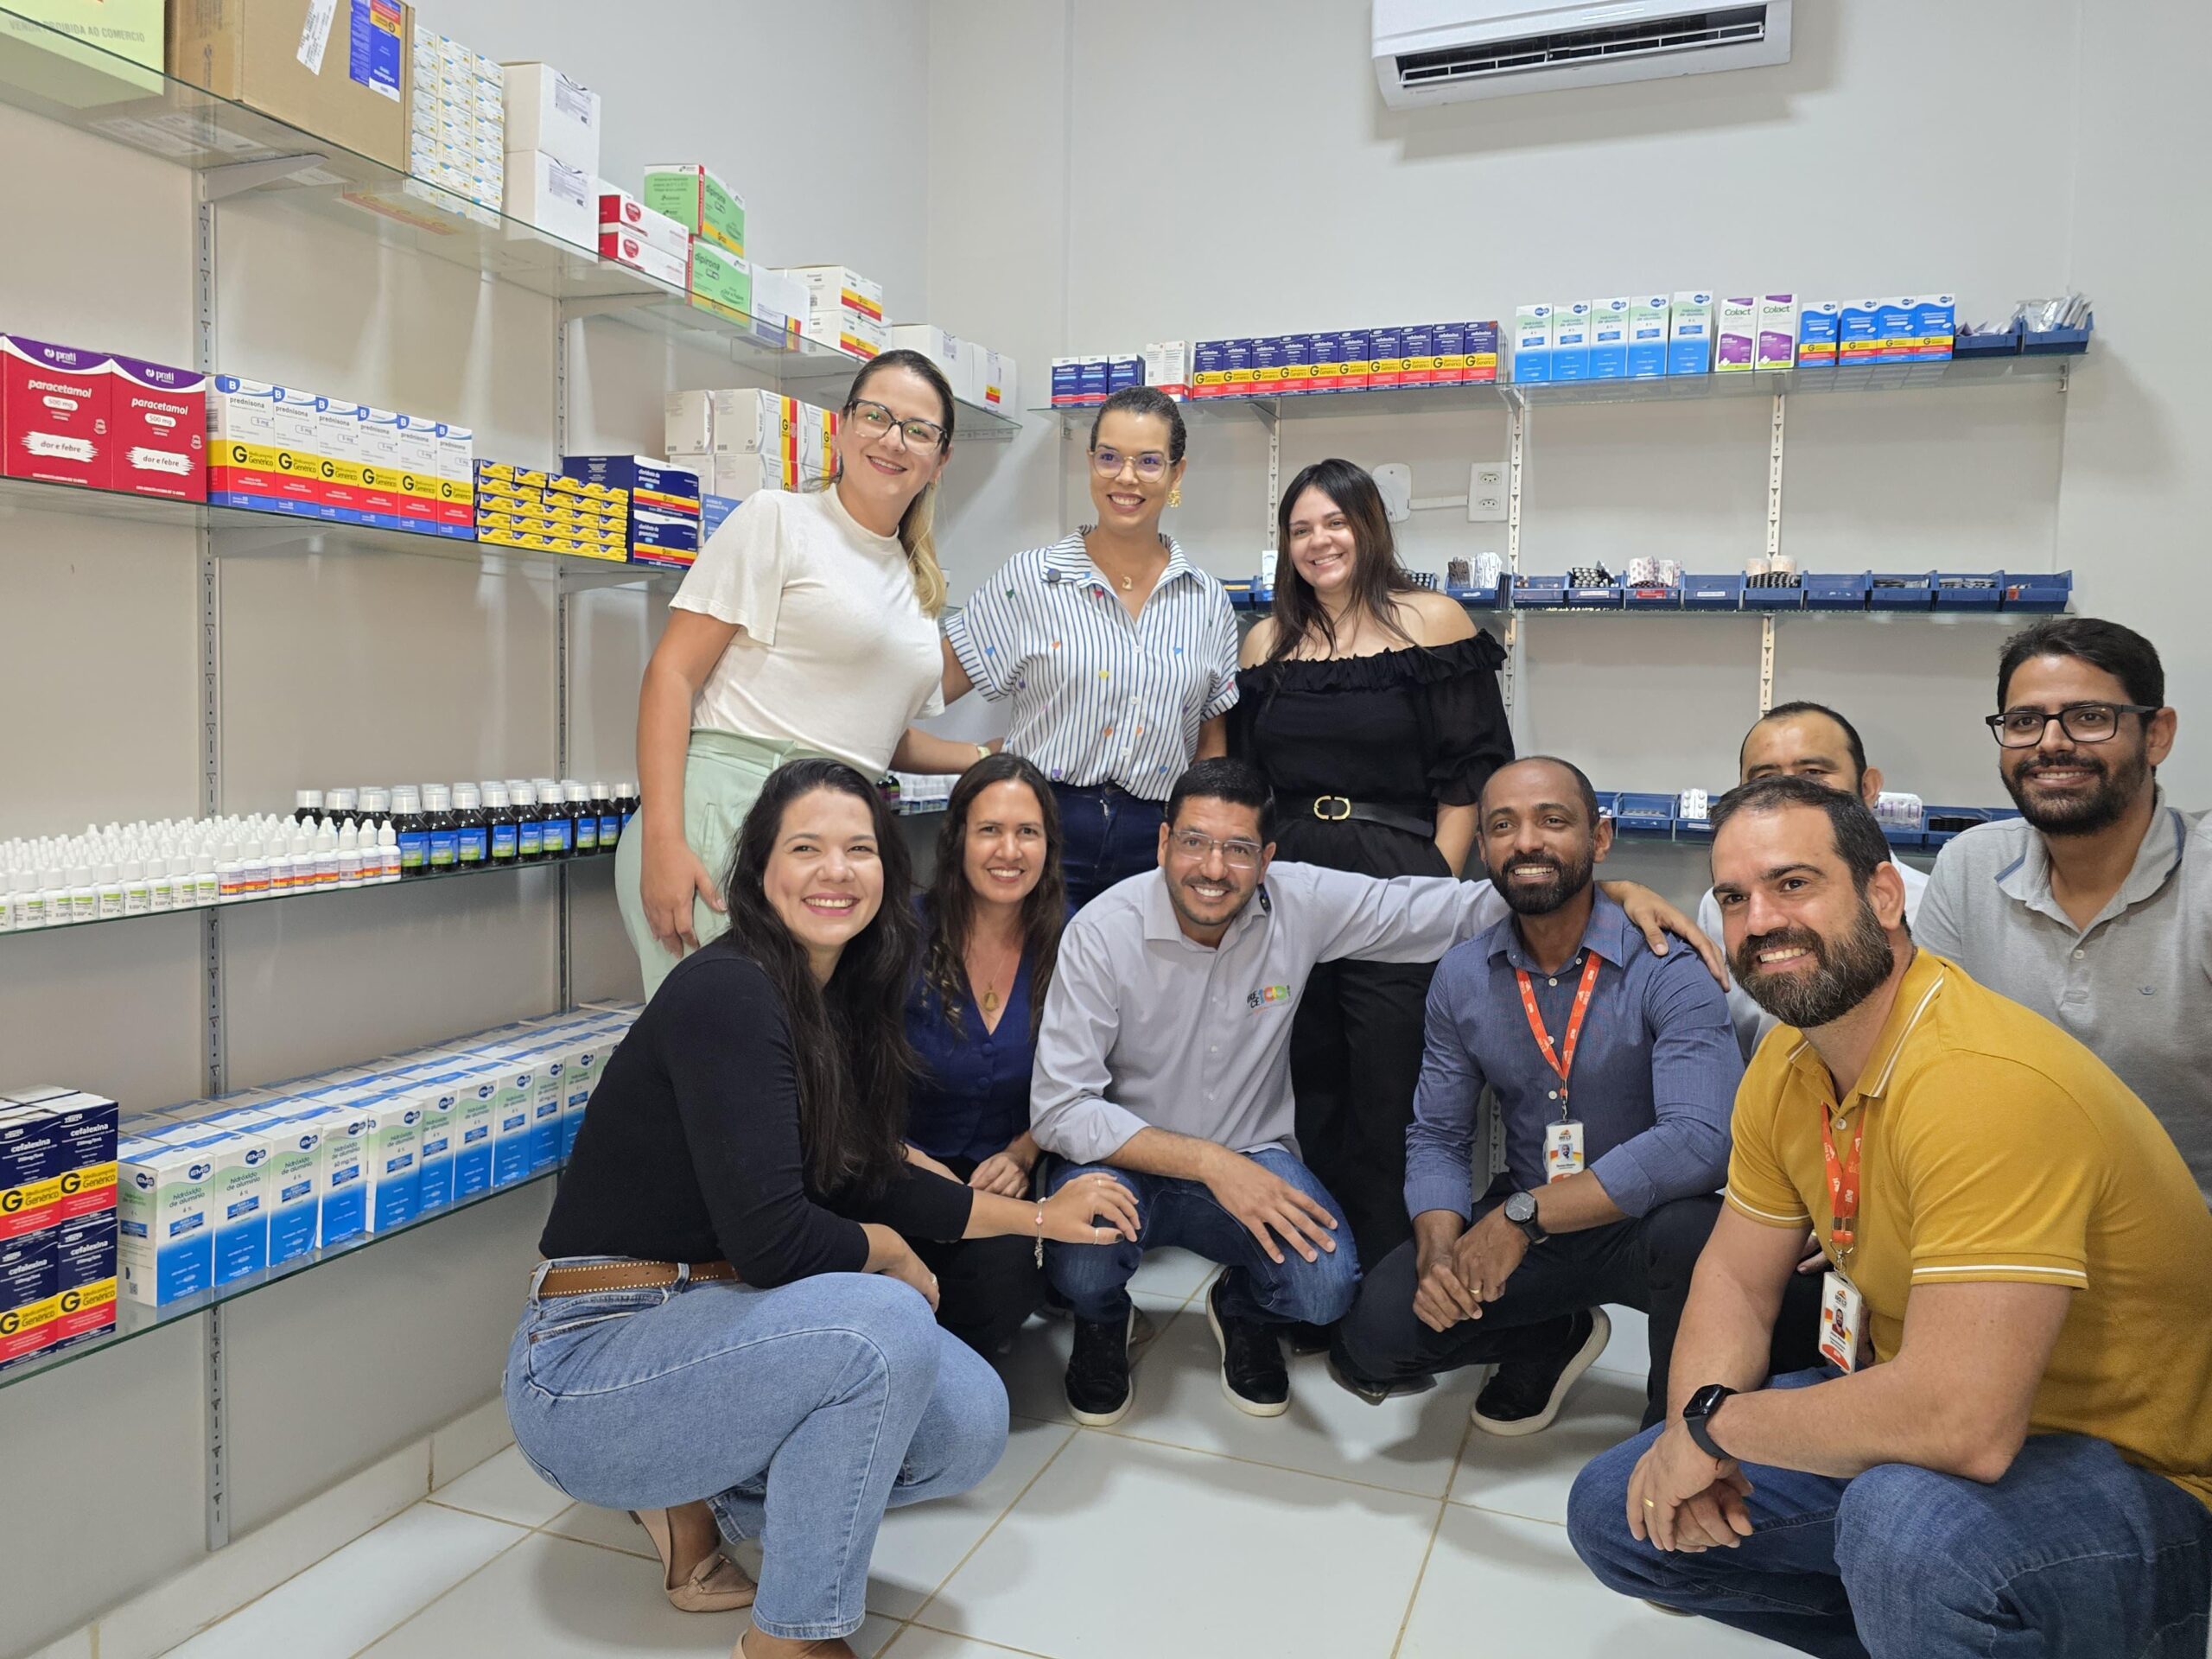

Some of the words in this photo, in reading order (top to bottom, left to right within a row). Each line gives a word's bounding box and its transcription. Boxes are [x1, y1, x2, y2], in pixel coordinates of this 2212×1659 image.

[1725, 308, 1751, 316] Colact
[1763, 305, 1791, 314] Colact
[55, 351, 77, 362] prati
[156, 370, 175, 381] prati
[28, 379, 92, 398] paracetamol
[229, 380, 237, 390] B
[275, 390, 282, 399] B
[48, 397, 61, 407] 500
[62, 401, 73, 410] mg
[131, 397, 189, 416] paracetamol
[229, 397, 265, 409] prednisona
[318, 400, 325, 409] B
[276, 405, 308, 417] prednisona
[360, 410, 366, 418] B
[149, 415, 162, 423] 500
[319, 416, 350, 427] prednisona
[400, 417, 407, 426] B
[782, 418, 789, 430] G
[360, 423, 390, 435] prednisona
[439, 425, 445, 435] B
[41, 441, 54, 449] dor
[61, 443, 81, 453] febre
[232, 445, 247, 463] G
[143, 454, 155, 463] dor
[162, 458, 180, 467] febre
[278, 453, 293, 470] G
[321, 461, 334, 478] G
[363, 468, 375, 485] G
[403, 475, 415, 491] G
[442, 482, 452, 498] G
[70, 1123, 109, 1137] cefalexina
[10, 1138, 51, 1153] cefalexina
[301, 1135, 318, 1147] EMS
[246, 1150, 266, 1161] EMS
[189, 1165, 210, 1177] EMS
[60, 1173, 81, 1194] G
[230, 1171, 257, 1184] hidróxido
[173, 1186, 202, 1200] hidróxido
[226, 1183, 236, 1192] de
[2, 1190, 23, 1212] G
[70, 1240, 109, 1256] cefalexina
[8, 1259, 48, 1275] cefalexina
[60, 1291, 81, 1313] G
[0, 1312, 20, 1335] G
